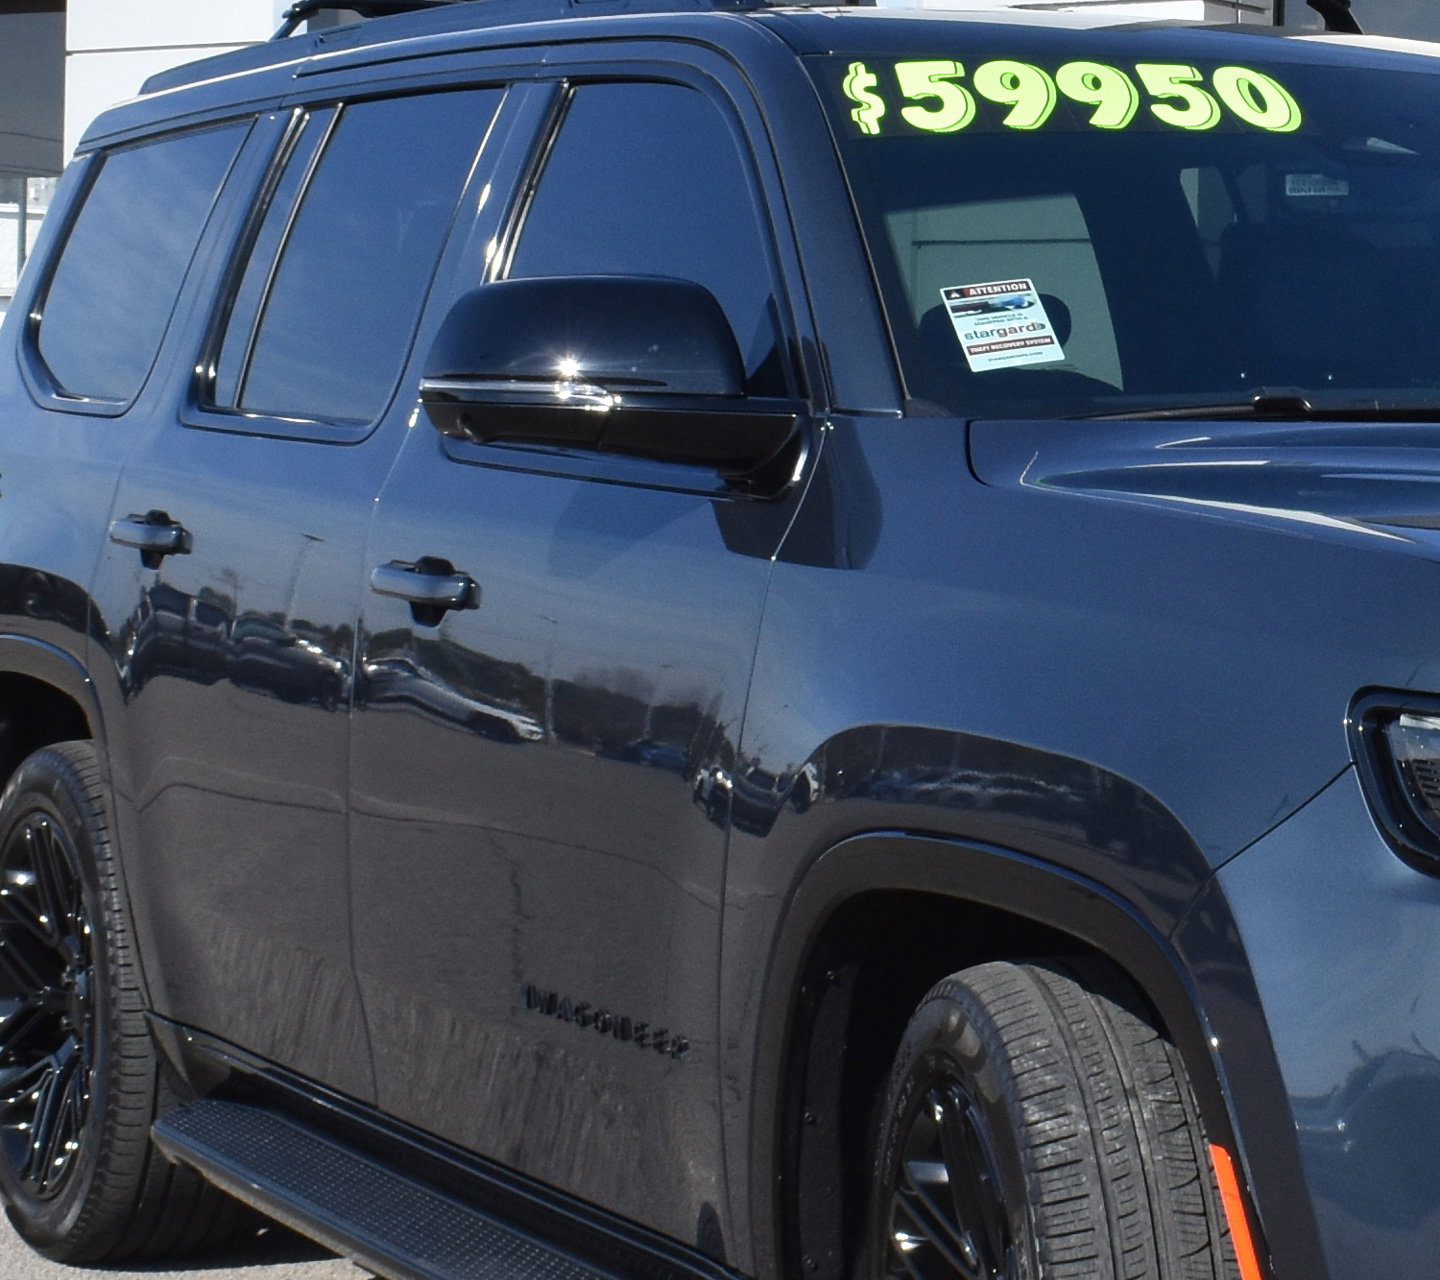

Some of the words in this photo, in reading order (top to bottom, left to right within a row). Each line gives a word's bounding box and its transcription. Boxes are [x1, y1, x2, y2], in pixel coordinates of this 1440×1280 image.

[842, 59, 1303, 135] $59950
[969, 282, 1028, 296] ATTENTION
[964, 321, 1036, 341] stargard
[519, 983, 691, 1061] WAGONEER
